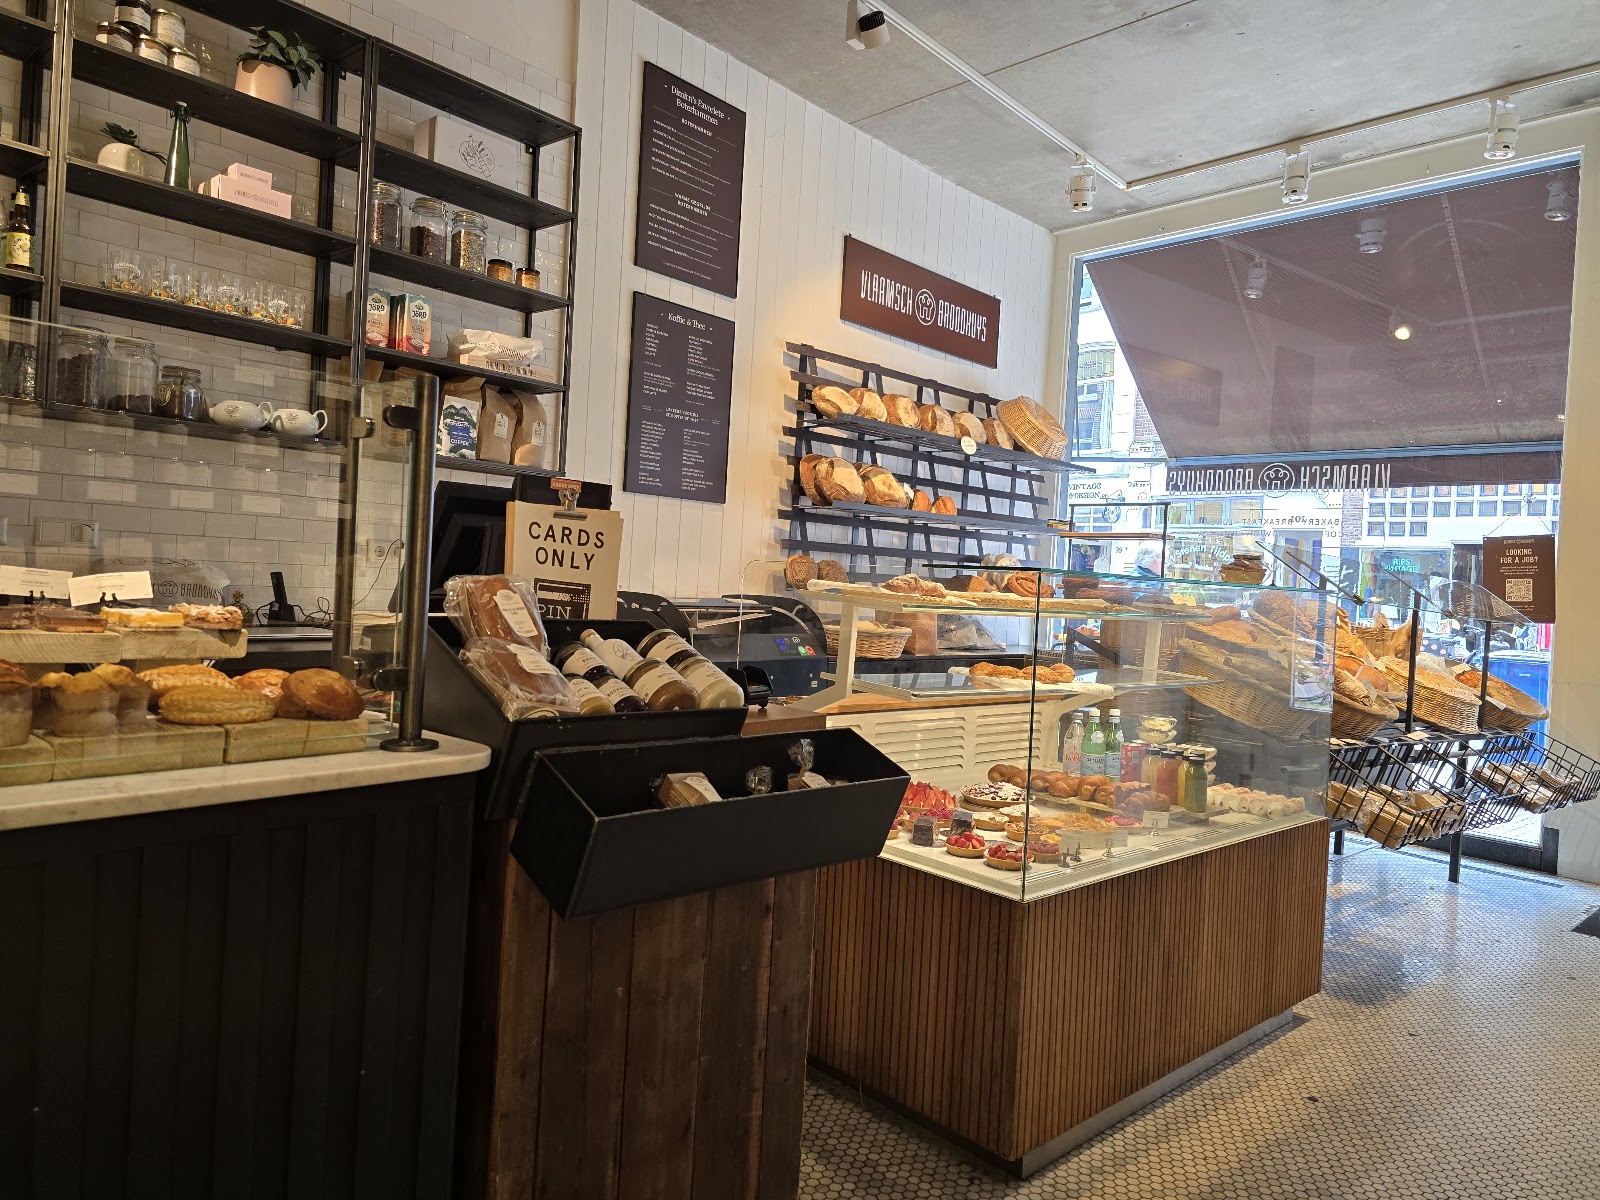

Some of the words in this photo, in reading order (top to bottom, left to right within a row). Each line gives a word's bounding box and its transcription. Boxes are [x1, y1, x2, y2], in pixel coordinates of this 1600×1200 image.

[676, 98, 719, 126] Boterhammen
[698, 99, 725, 119] Favoriete
[860, 269, 913, 316] VLAAMSCH
[937, 299, 987, 342] BROODHUYS
[668, 312, 686, 325] Koffie
[692, 319, 706, 331] Thee
[1069, 483, 1102, 491] VINTAGE
[528, 521, 605, 549] CARDS
[535, 546, 596, 570] ONLY
[1175, 544, 1207, 558] Stenen
[1500, 556, 1513, 564] FOR
[1514, 556, 1520, 564] A
[1505, 548, 1533, 556] LOOKING
